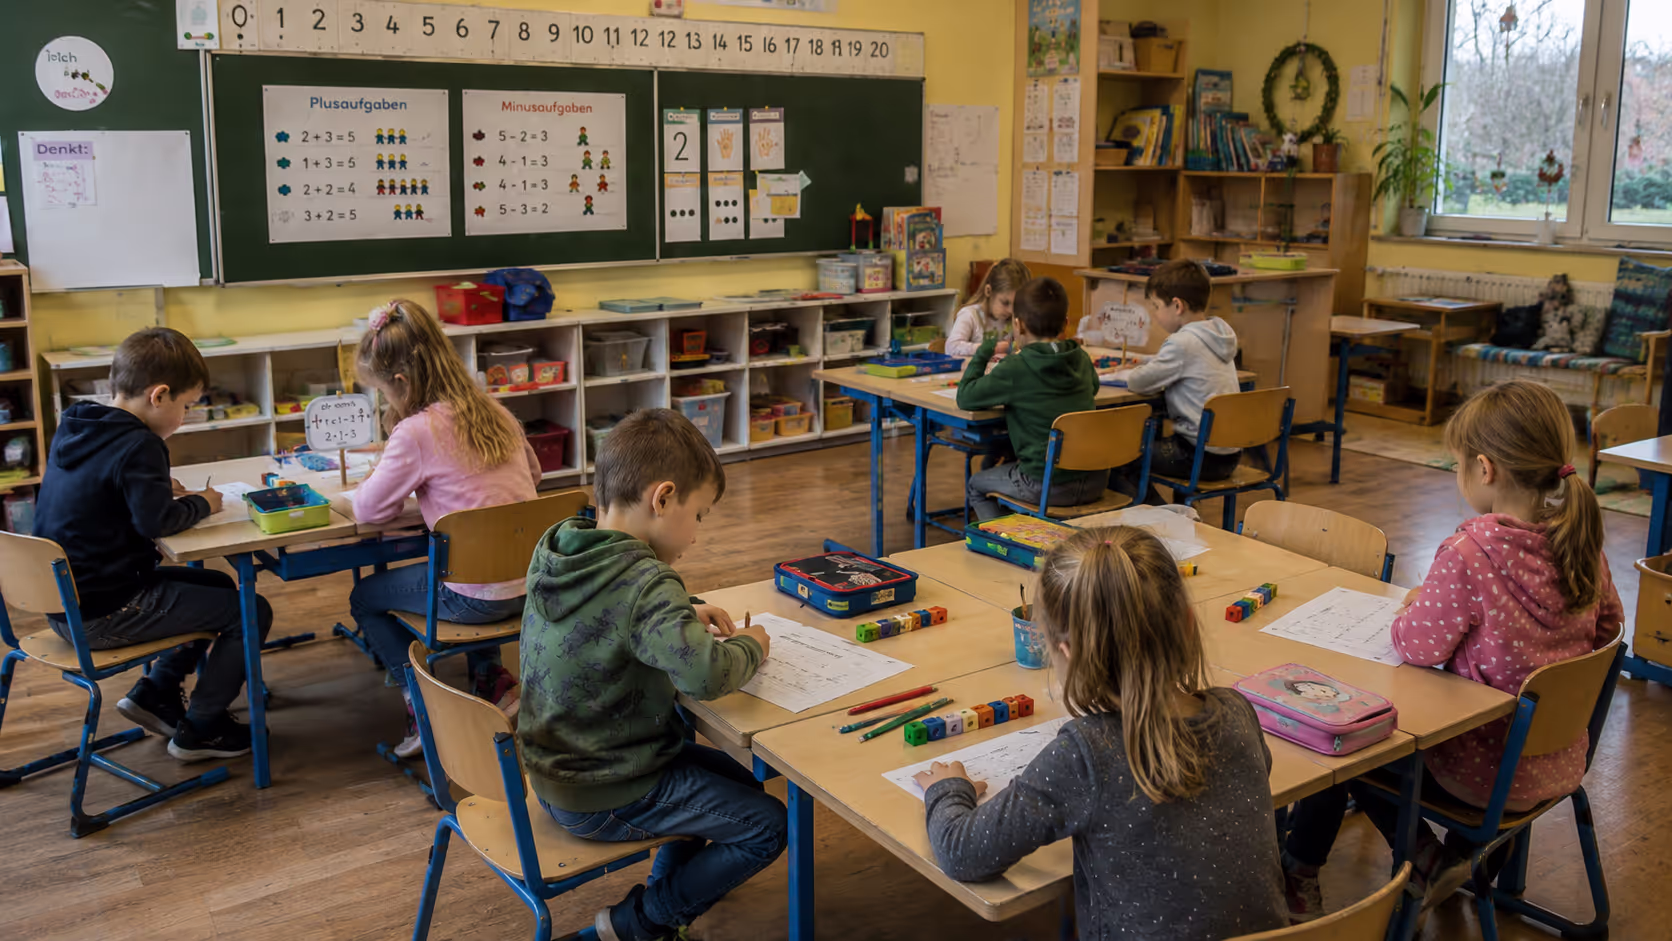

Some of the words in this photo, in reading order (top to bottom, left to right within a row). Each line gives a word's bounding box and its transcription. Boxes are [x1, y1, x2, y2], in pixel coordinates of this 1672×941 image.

[232, 4, 247, 28] 0
[277, 7, 284, 28] 1
[312, 8, 326, 31] 2
[351, 13, 364, 32] 3
[386, 15, 400, 34] 4
[423, 16, 435, 36] 5
[456, 18, 469, 38] 6
[488, 20, 500, 39] 7
[518, 22, 530, 41] 8
[548, 23, 560, 42] 9
[573, 25, 593, 44] 10
[604, 27, 619, 45] 11
[631, 28, 648, 47] 12
[658, 30, 676, 48] 12
[685, 32, 702, 50] 13
[713, 33, 728, 50] 14
[737, 34, 752, 52] 15
[763, 36, 777, 53] 16
[785, 37, 800, 54] 17
[808, 39, 823, 56] 18
[848, 41, 862, 57] 19
[869, 41, 889, 58] 20
[310, 96, 408, 113] Plusaufgaben
[302, 131, 309, 142] 2
[325, 131, 332, 142] 3
[348, 131, 355, 142] 5
[499, 130, 506, 141] 5
[520, 131, 527, 142] 2
[541, 130, 548, 142] 3
[37, 144, 89, 155] Denkt:
[673, 132, 689, 161] 2
[302, 157, 308, 169] 1
[325, 157, 332, 168] 3
[348, 157, 355, 168] 5
[498, 155, 507, 166] 4
[521, 156, 526, 166] 1
[541, 155, 548, 167] 3
[304, 184, 310, 195] 2
[326, 184, 333, 195] 2
[348, 182, 355, 194] 4
[499, 179, 506, 190] 4
[521, 180, 526, 191] 1
[541, 179, 548, 190] 3
[305, 210, 311, 221] 3
[326, 210, 333, 221] 2
[350, 209, 357, 220] 5
[500, 204, 507, 215] 5
[521, 204, 527, 215] 3
[542, 203, 548, 214] 2
